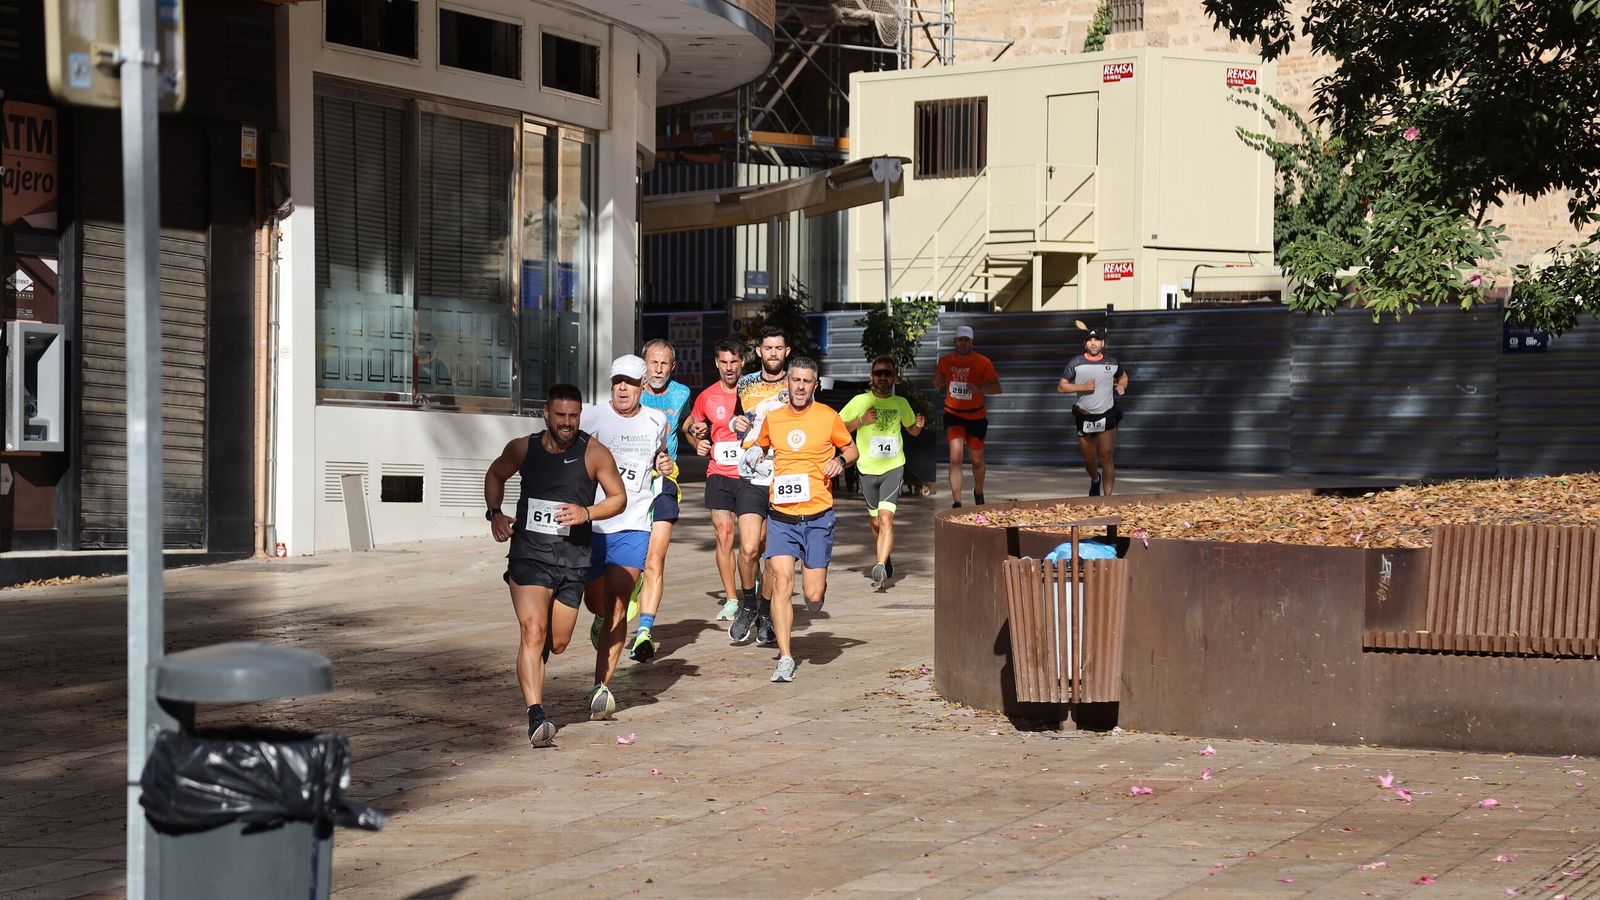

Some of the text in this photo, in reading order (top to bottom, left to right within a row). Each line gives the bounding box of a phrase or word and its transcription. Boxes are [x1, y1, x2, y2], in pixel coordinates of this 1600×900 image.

[1104, 64, 1133, 75] REMSA
[1227, 69, 1256, 80] REMSA
[3, 161, 54, 196] ajero
[1104, 262, 1133, 274] REMSA
[723, 449, 737, 458] 13
[878, 444, 891, 452] 14
[778, 484, 802, 495] 839
[533, 510, 558, 524] 61
